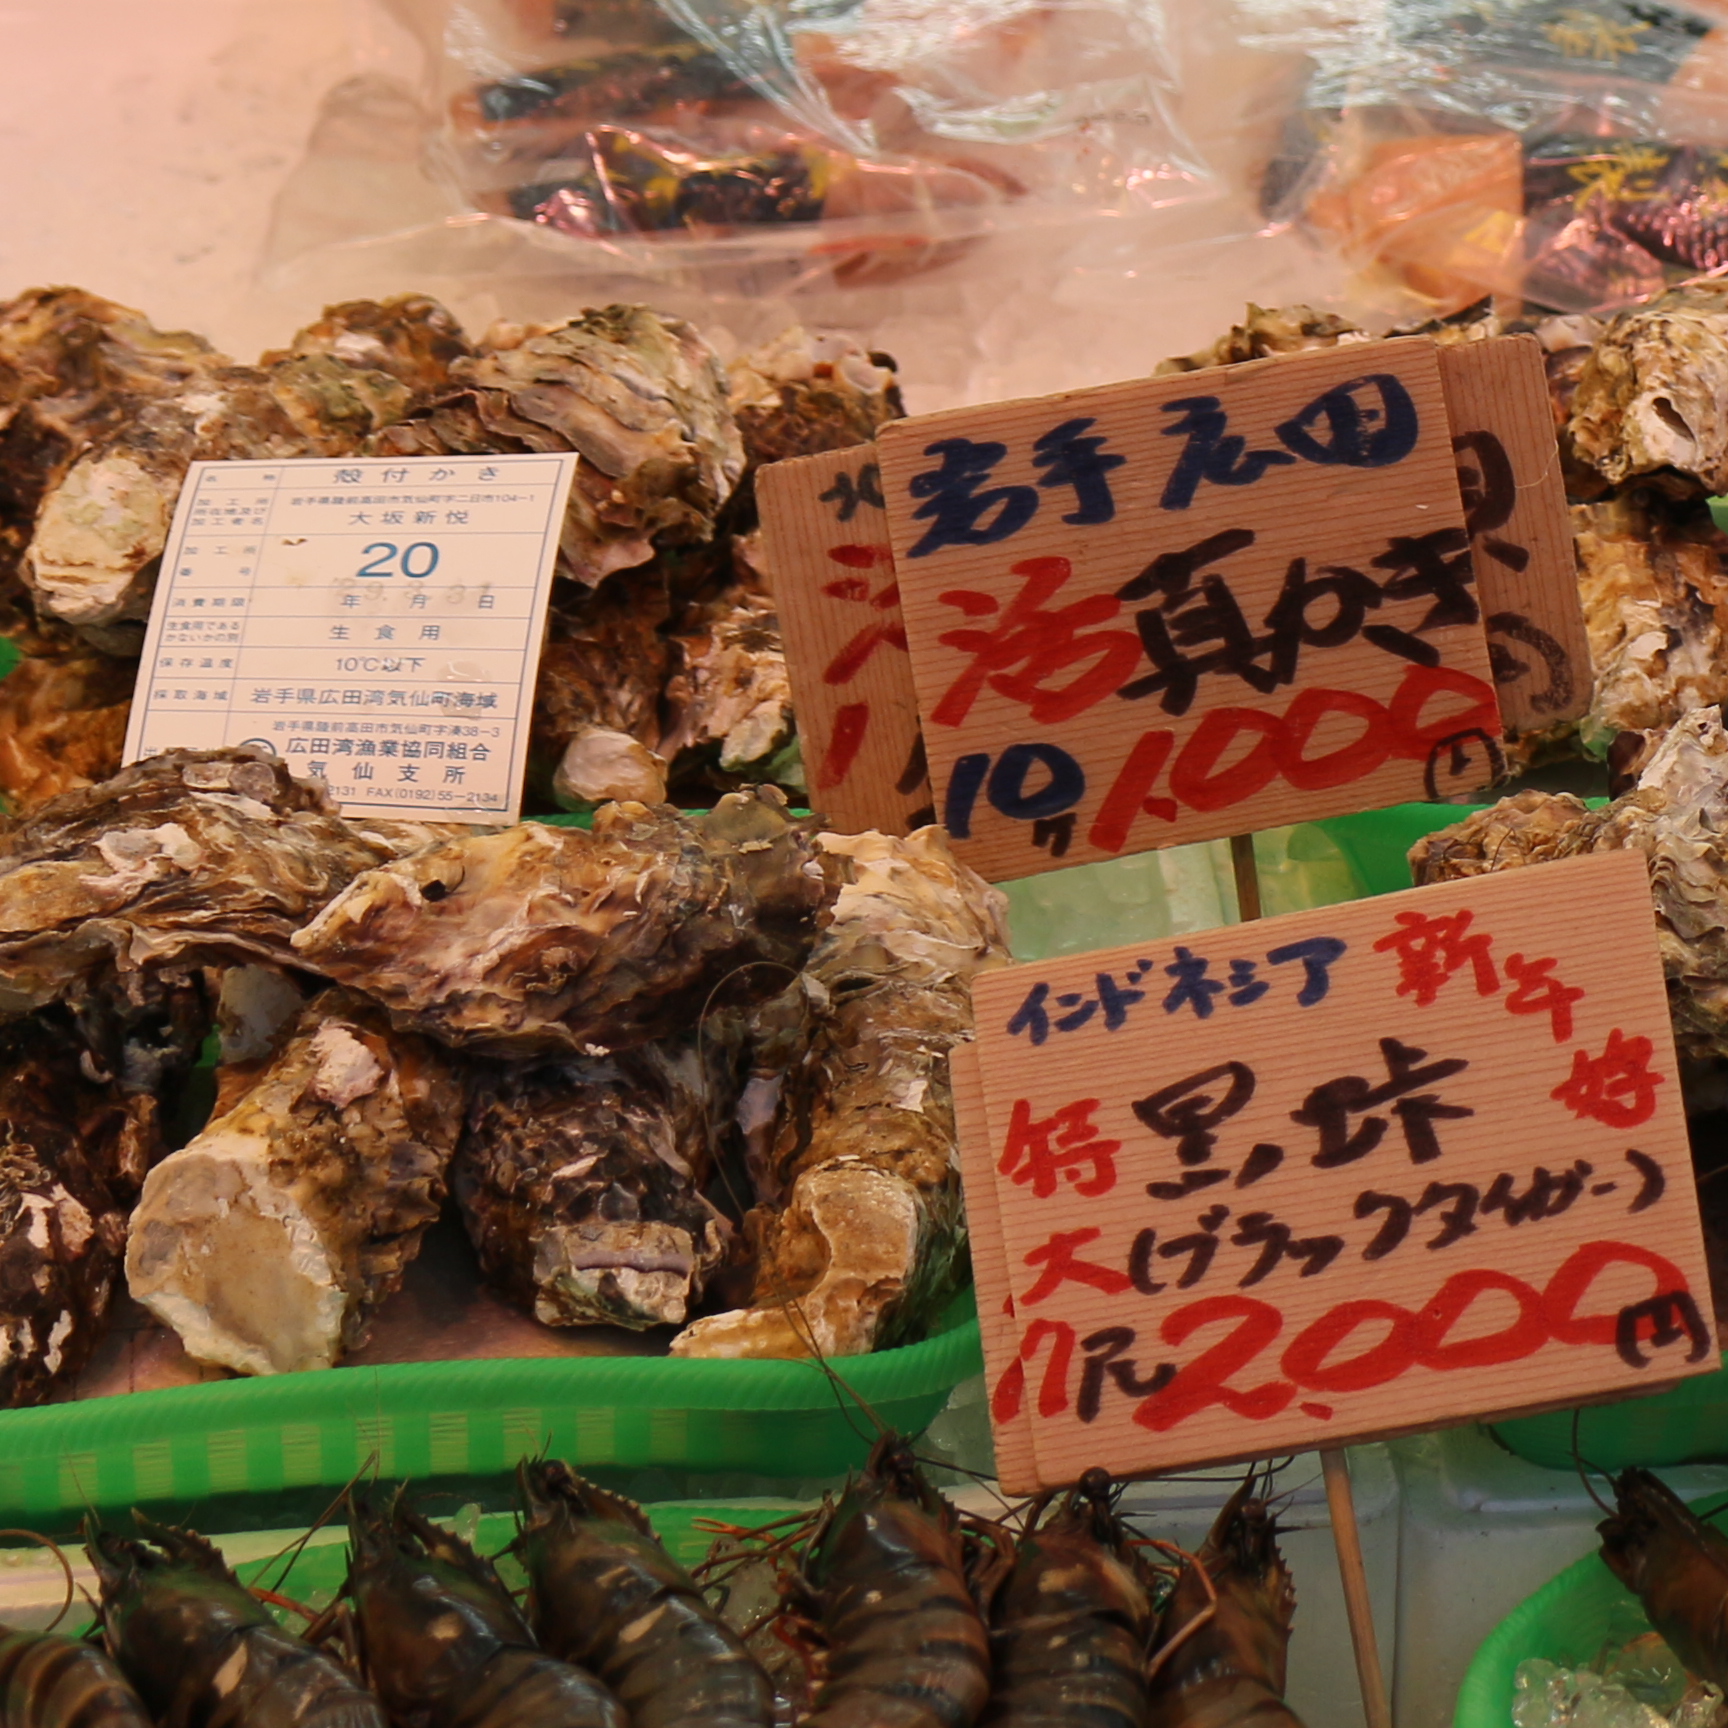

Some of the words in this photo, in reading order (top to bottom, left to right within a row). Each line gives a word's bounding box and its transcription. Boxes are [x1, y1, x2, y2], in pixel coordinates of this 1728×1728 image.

[355, 541, 439, 578] 20
[1007, 936, 1348, 1046] インドネシア
